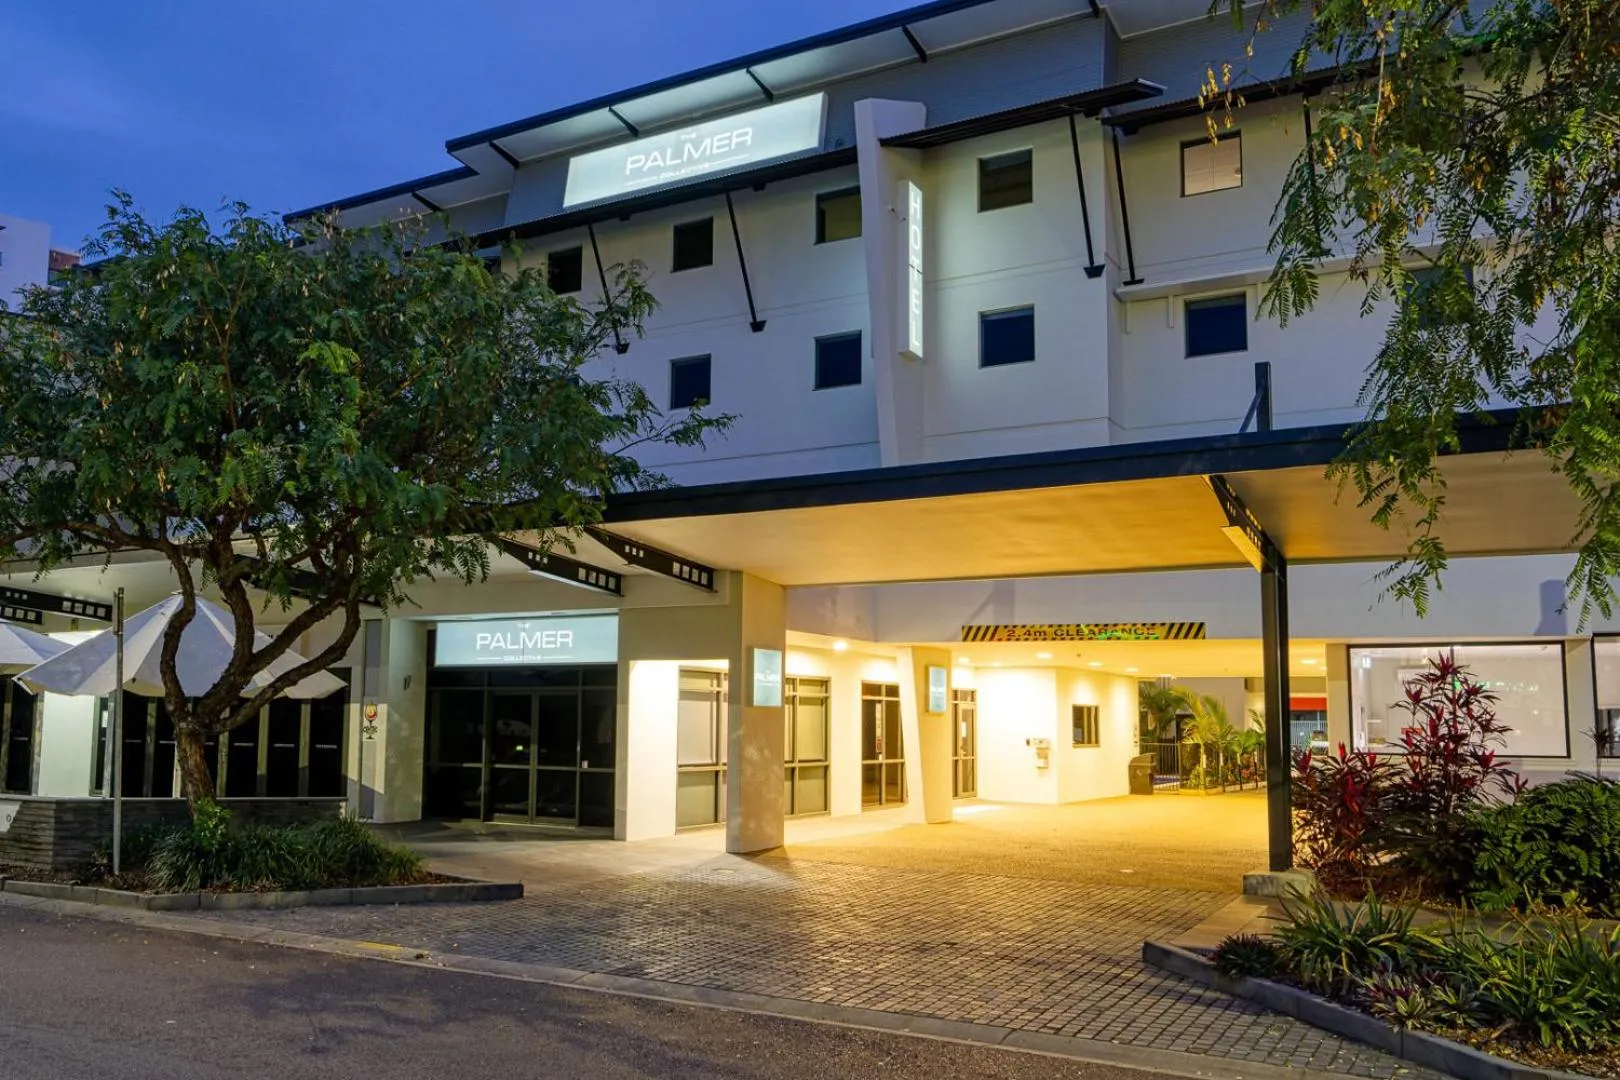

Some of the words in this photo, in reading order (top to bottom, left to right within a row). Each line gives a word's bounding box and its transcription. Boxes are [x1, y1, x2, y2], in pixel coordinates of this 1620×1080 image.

[625, 126, 753, 176] PALMER
[910, 186, 920, 346] HOTEL
[476, 630, 573, 651] PALMER
[1006, 629, 1047, 638] 2.4m
[1053, 627, 1157, 637] CLEARANCE
